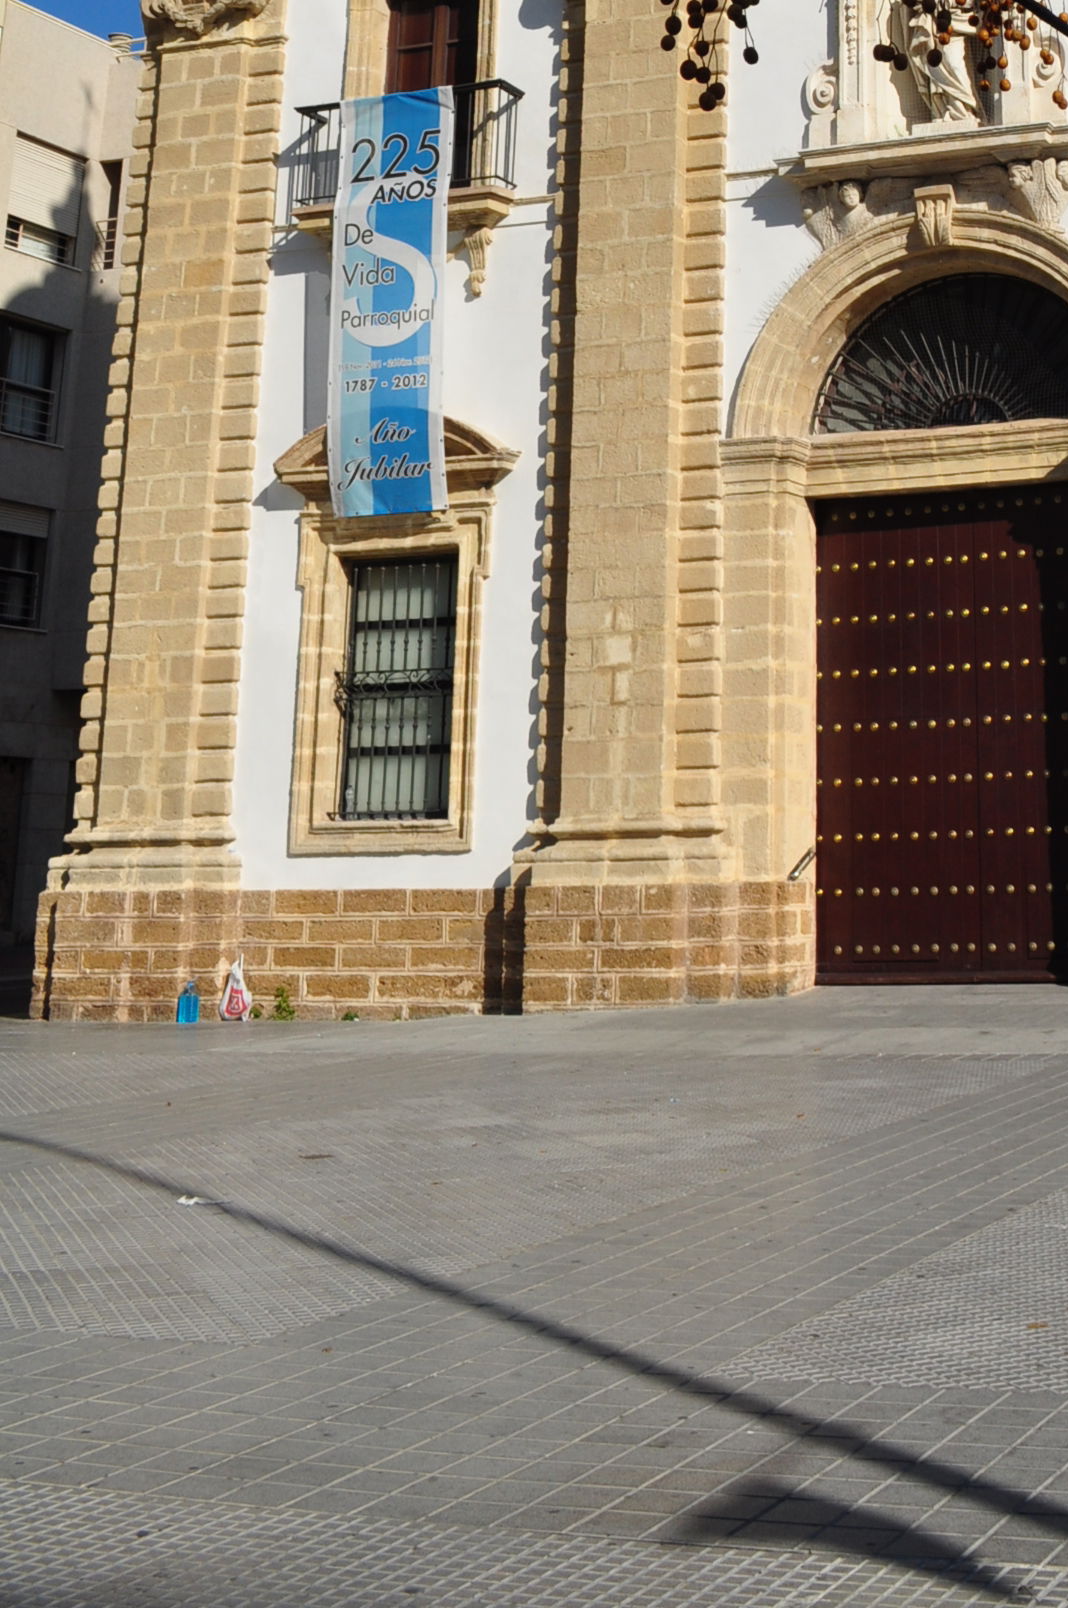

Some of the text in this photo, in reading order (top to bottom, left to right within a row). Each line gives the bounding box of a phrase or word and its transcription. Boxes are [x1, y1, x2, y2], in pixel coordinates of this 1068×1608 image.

[351, 129, 441, 184] 225
[370, 178, 438, 204] AÑOS
[344, 223, 374, 246] De
[342, 257, 395, 287] Vida
[341, 299, 434, 329] Parroquial
[345, 378, 376, 393] 1787
[393, 374, 427, 389] 2012
[355, 418, 416, 444] Año
[337, 453, 432, 490] Jubilar
